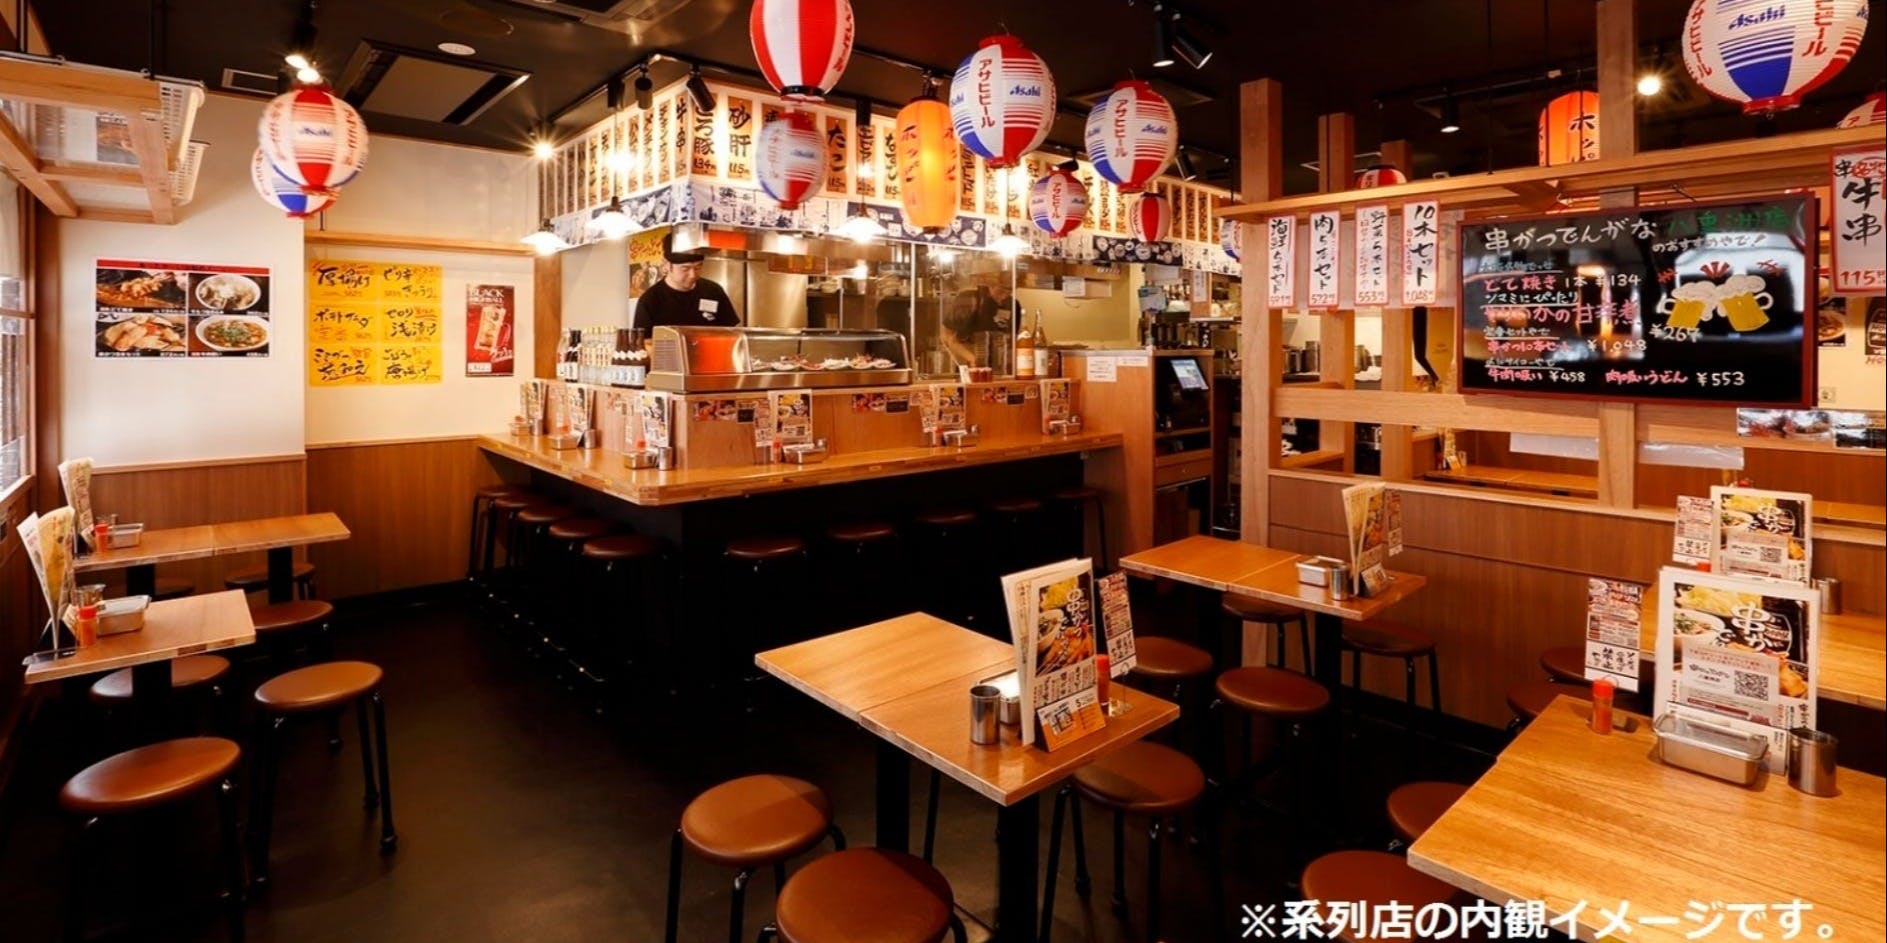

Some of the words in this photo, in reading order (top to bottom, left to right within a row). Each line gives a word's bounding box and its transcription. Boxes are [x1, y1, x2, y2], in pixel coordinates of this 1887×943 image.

[1727, 4, 1785, 29] Asahi
[978, 58, 996, 129] アサヒビール
[1008, 85, 1041, 97] Asahi
[728, 104, 752, 158] 砂肝
[827, 123, 846, 173] たこ
[1114, 98, 1128, 158] アサヒビール
[1841, 178, 1882, 248] 牛串
[1409, 205, 1438, 287] 10本セット
[1549, 370, 1587, 383] ¥458
[1696, 370, 1746, 387] ¥553
